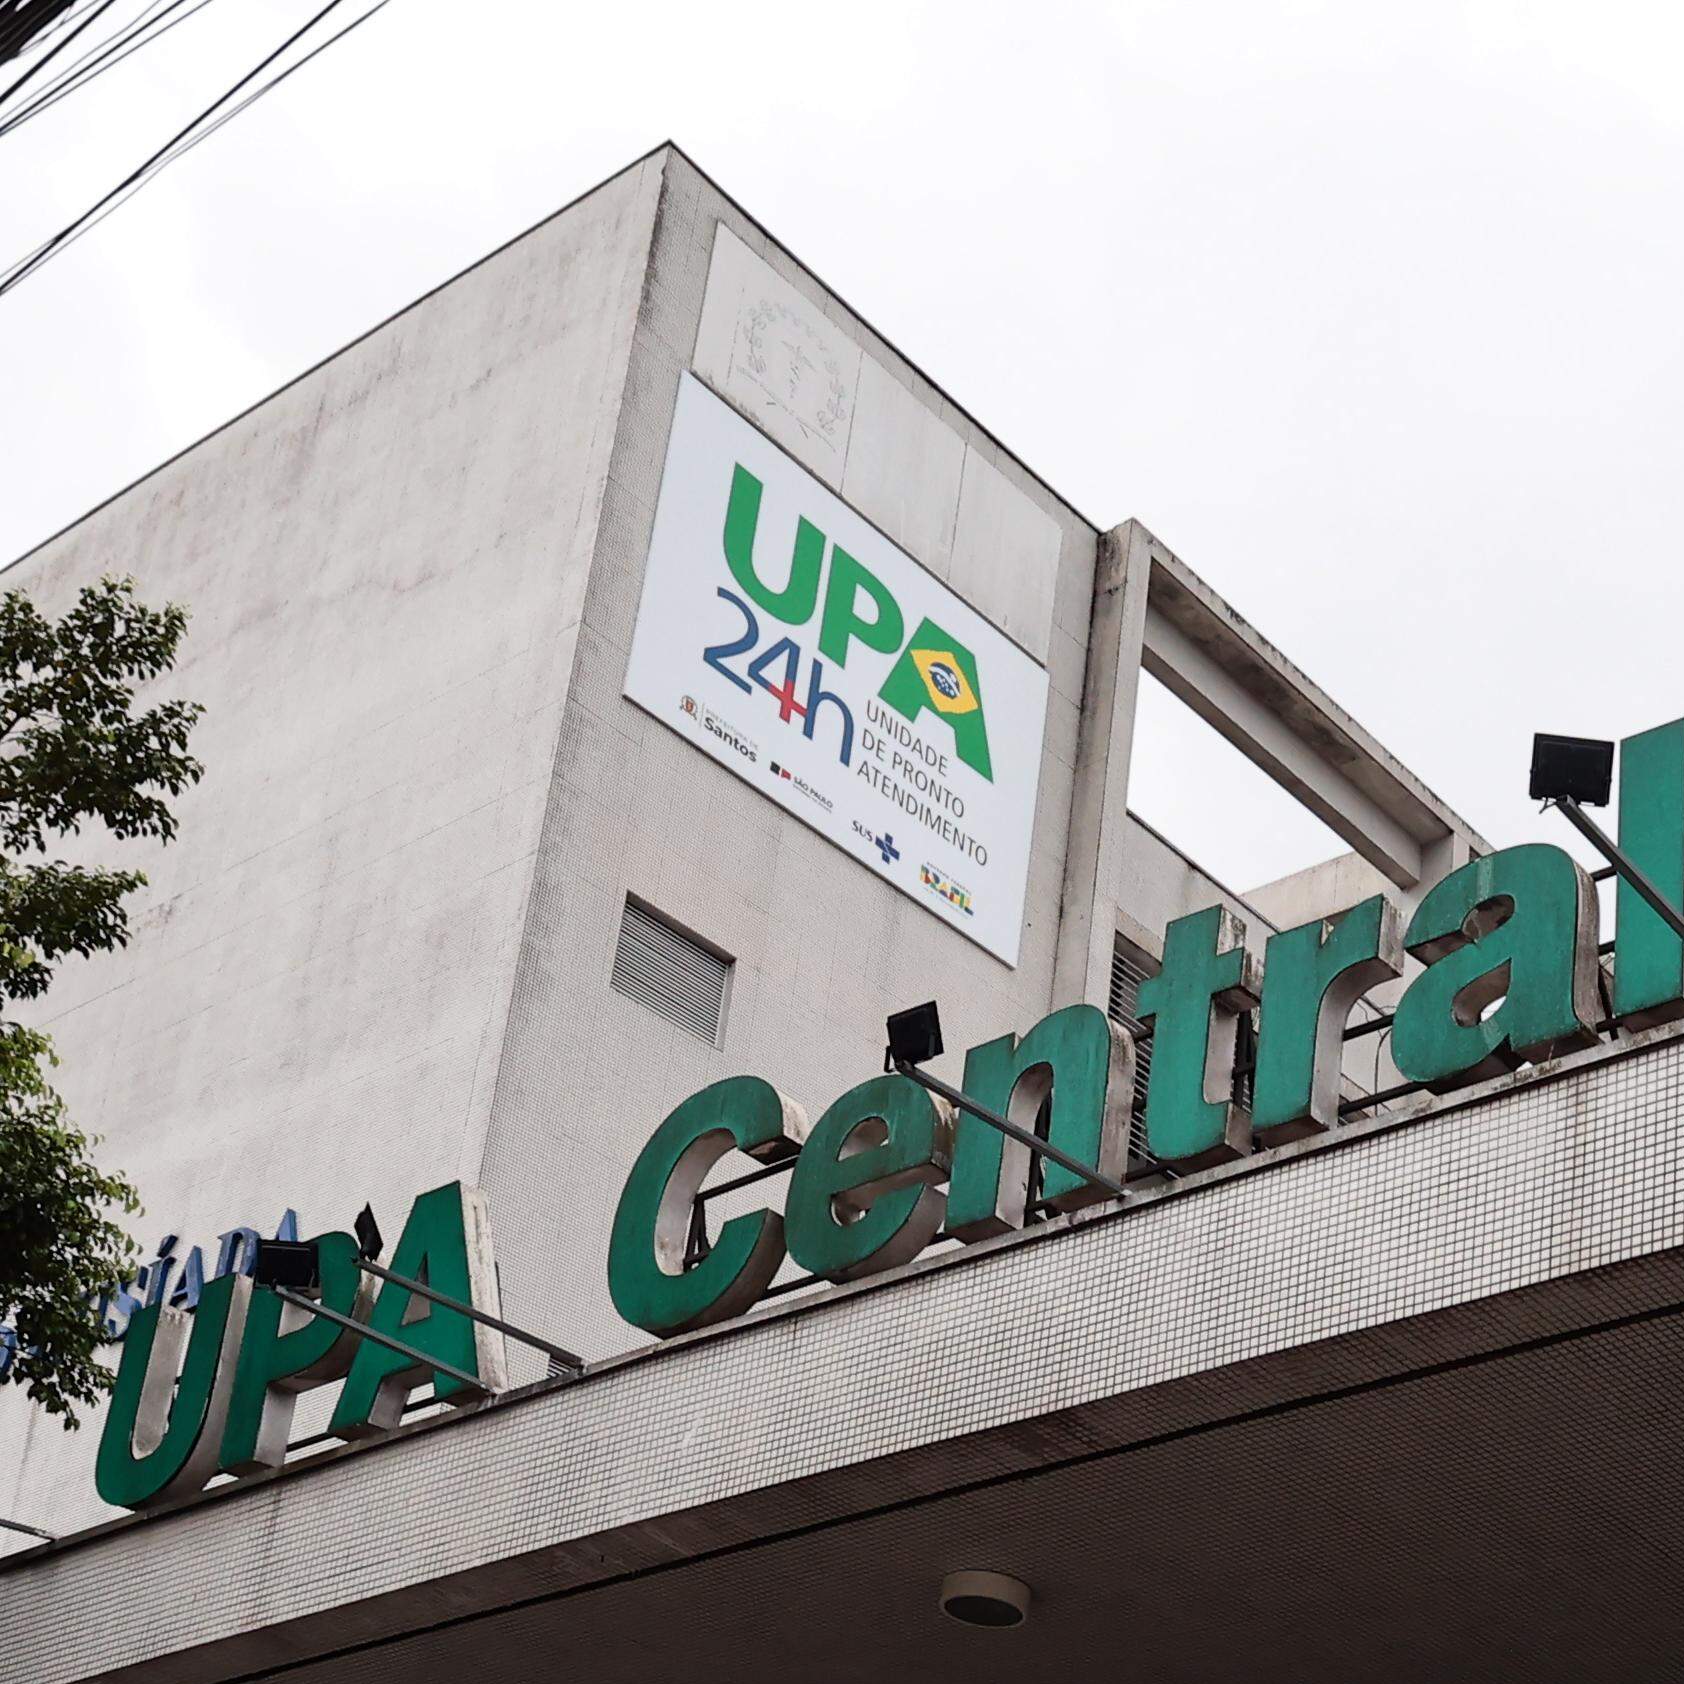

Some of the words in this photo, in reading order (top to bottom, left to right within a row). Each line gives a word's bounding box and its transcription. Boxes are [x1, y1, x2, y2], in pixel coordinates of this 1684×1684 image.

[723, 462, 994, 784] UPA
[703, 586, 855, 768] 24h
[704, 716, 758, 763] Santos
[861, 728, 887, 762] DE
[891, 751, 965, 818] PRONTO
[867, 699, 949, 778] UNIDADE
[852, 820, 873, 842] SUS
[857, 760, 988, 866] ATENDIMENTO
[95, 1179, 508, 1511] UPA
